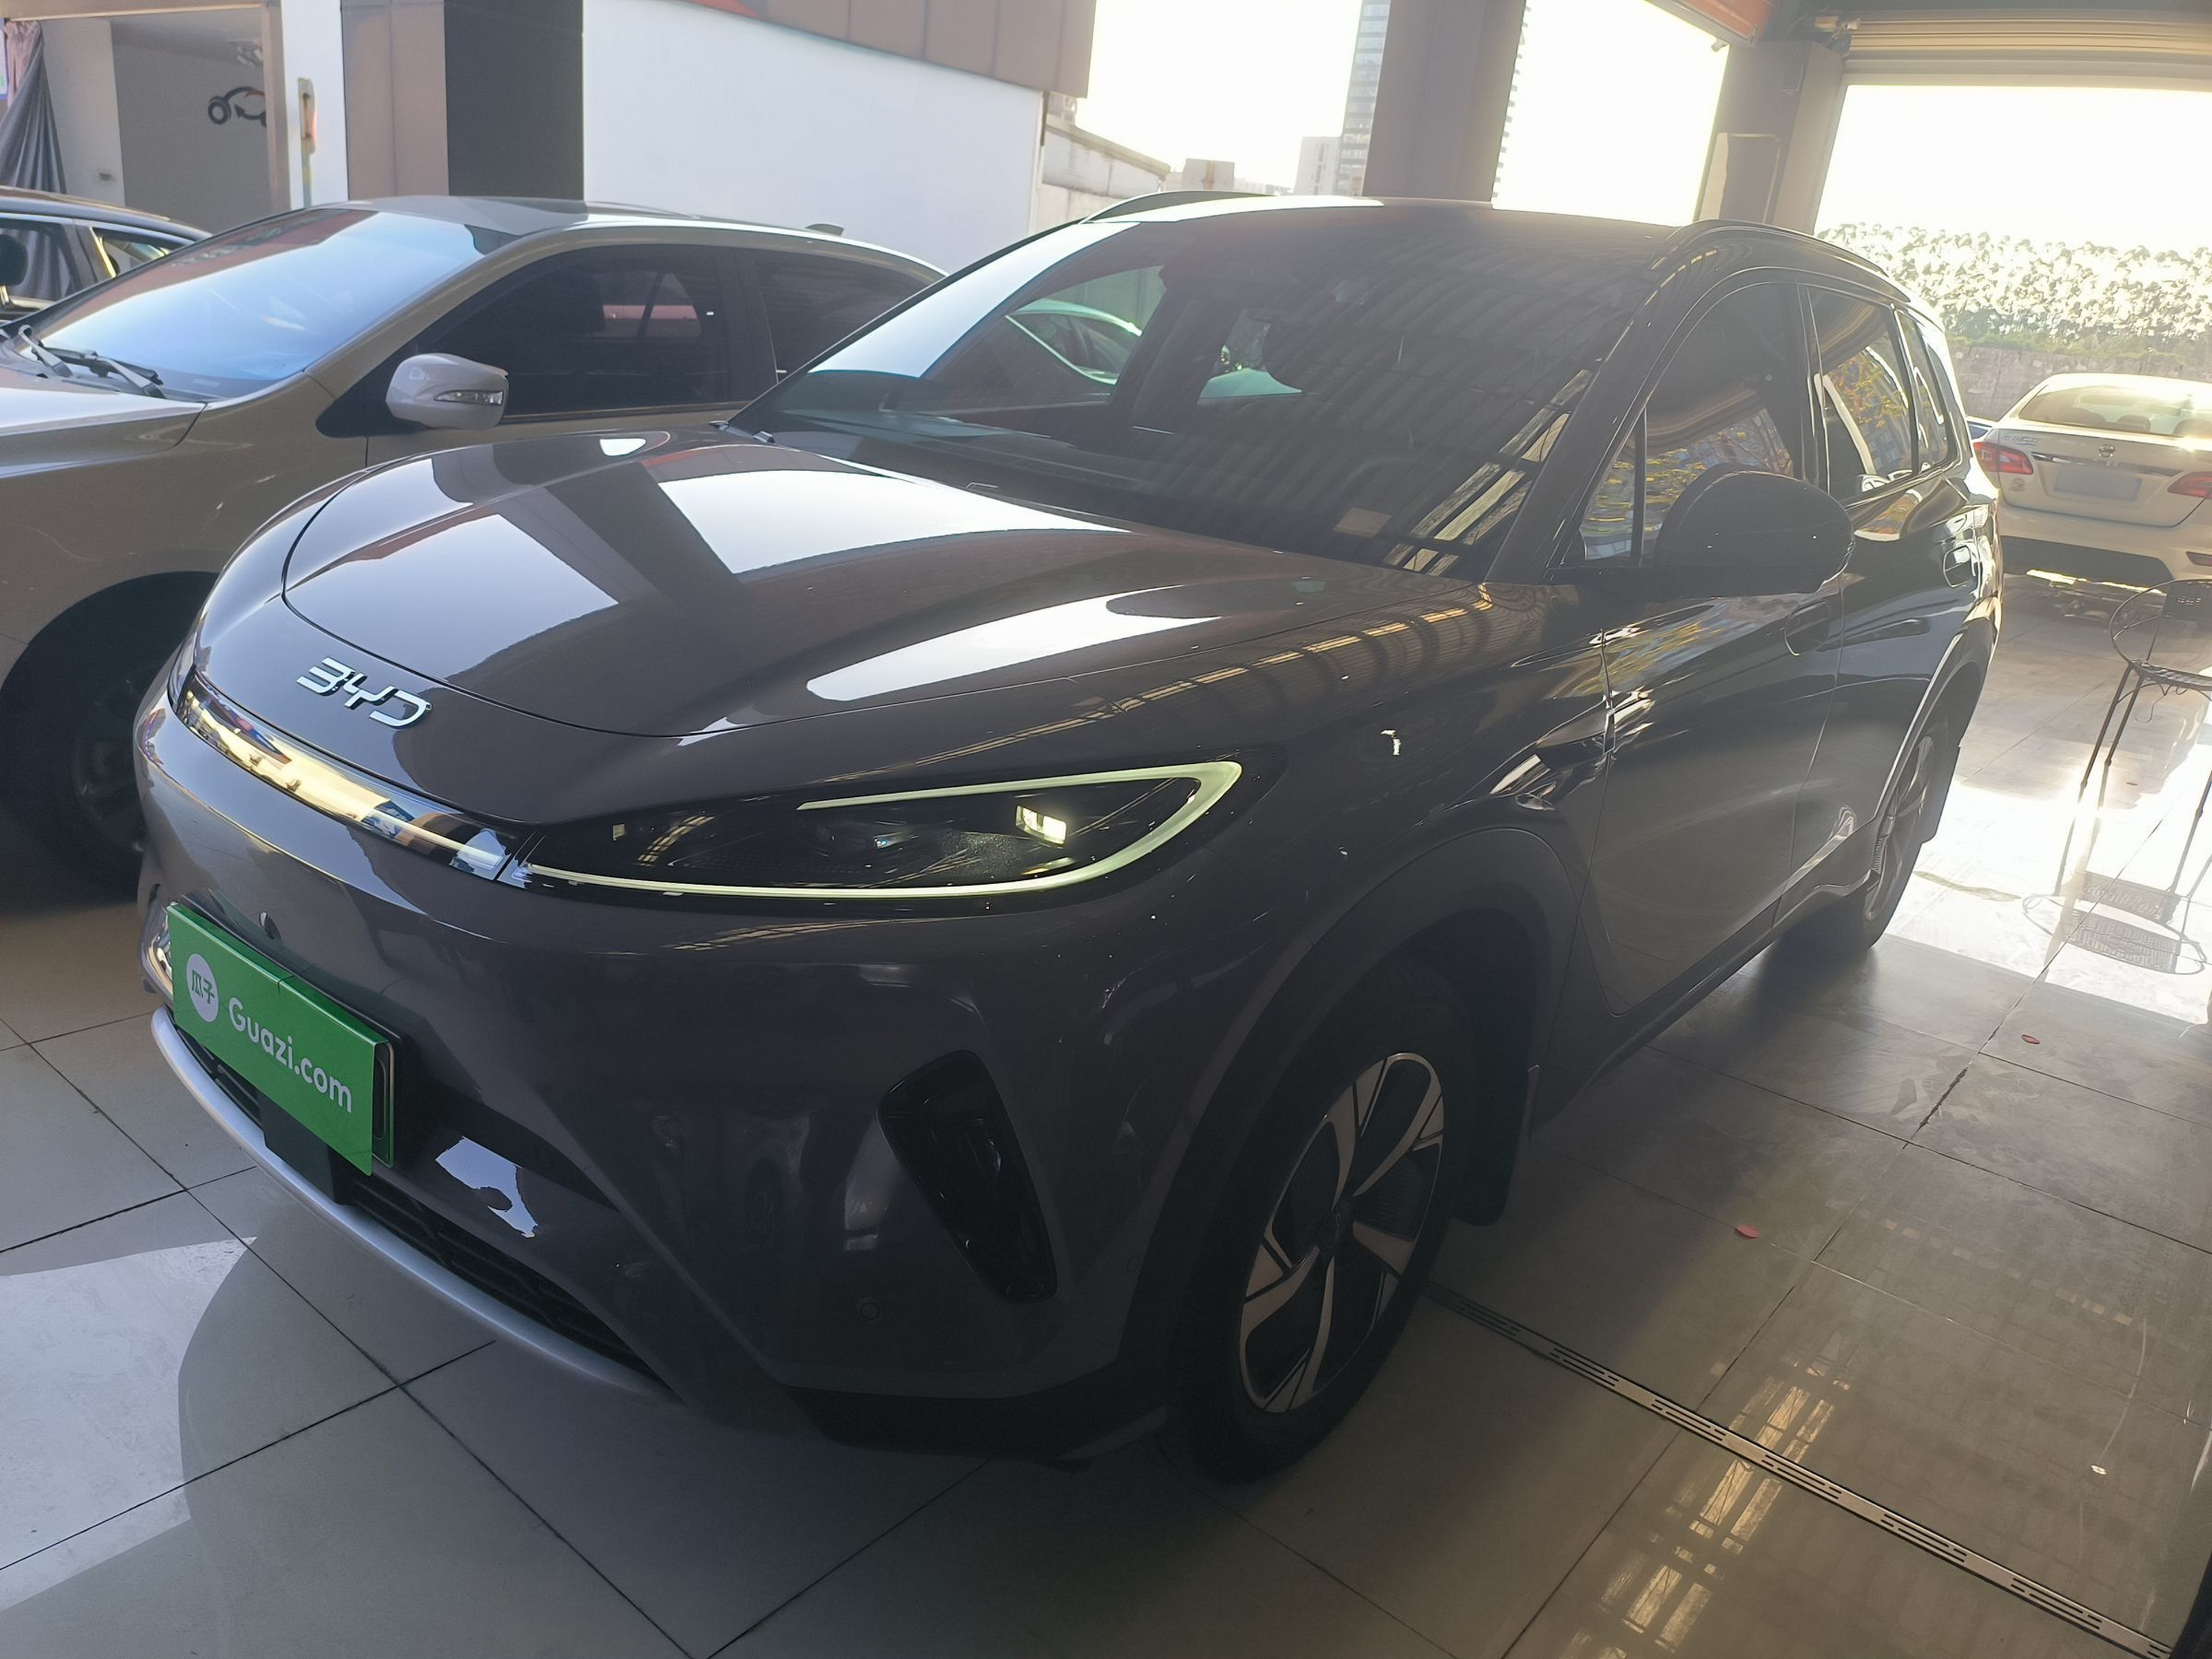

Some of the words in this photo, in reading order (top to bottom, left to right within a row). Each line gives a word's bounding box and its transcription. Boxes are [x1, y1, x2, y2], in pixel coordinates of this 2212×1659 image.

[296, 657, 427, 728] BYD
[192, 969, 215, 1004] 瓜子
[229, 997, 352, 1113] Guazi.com
